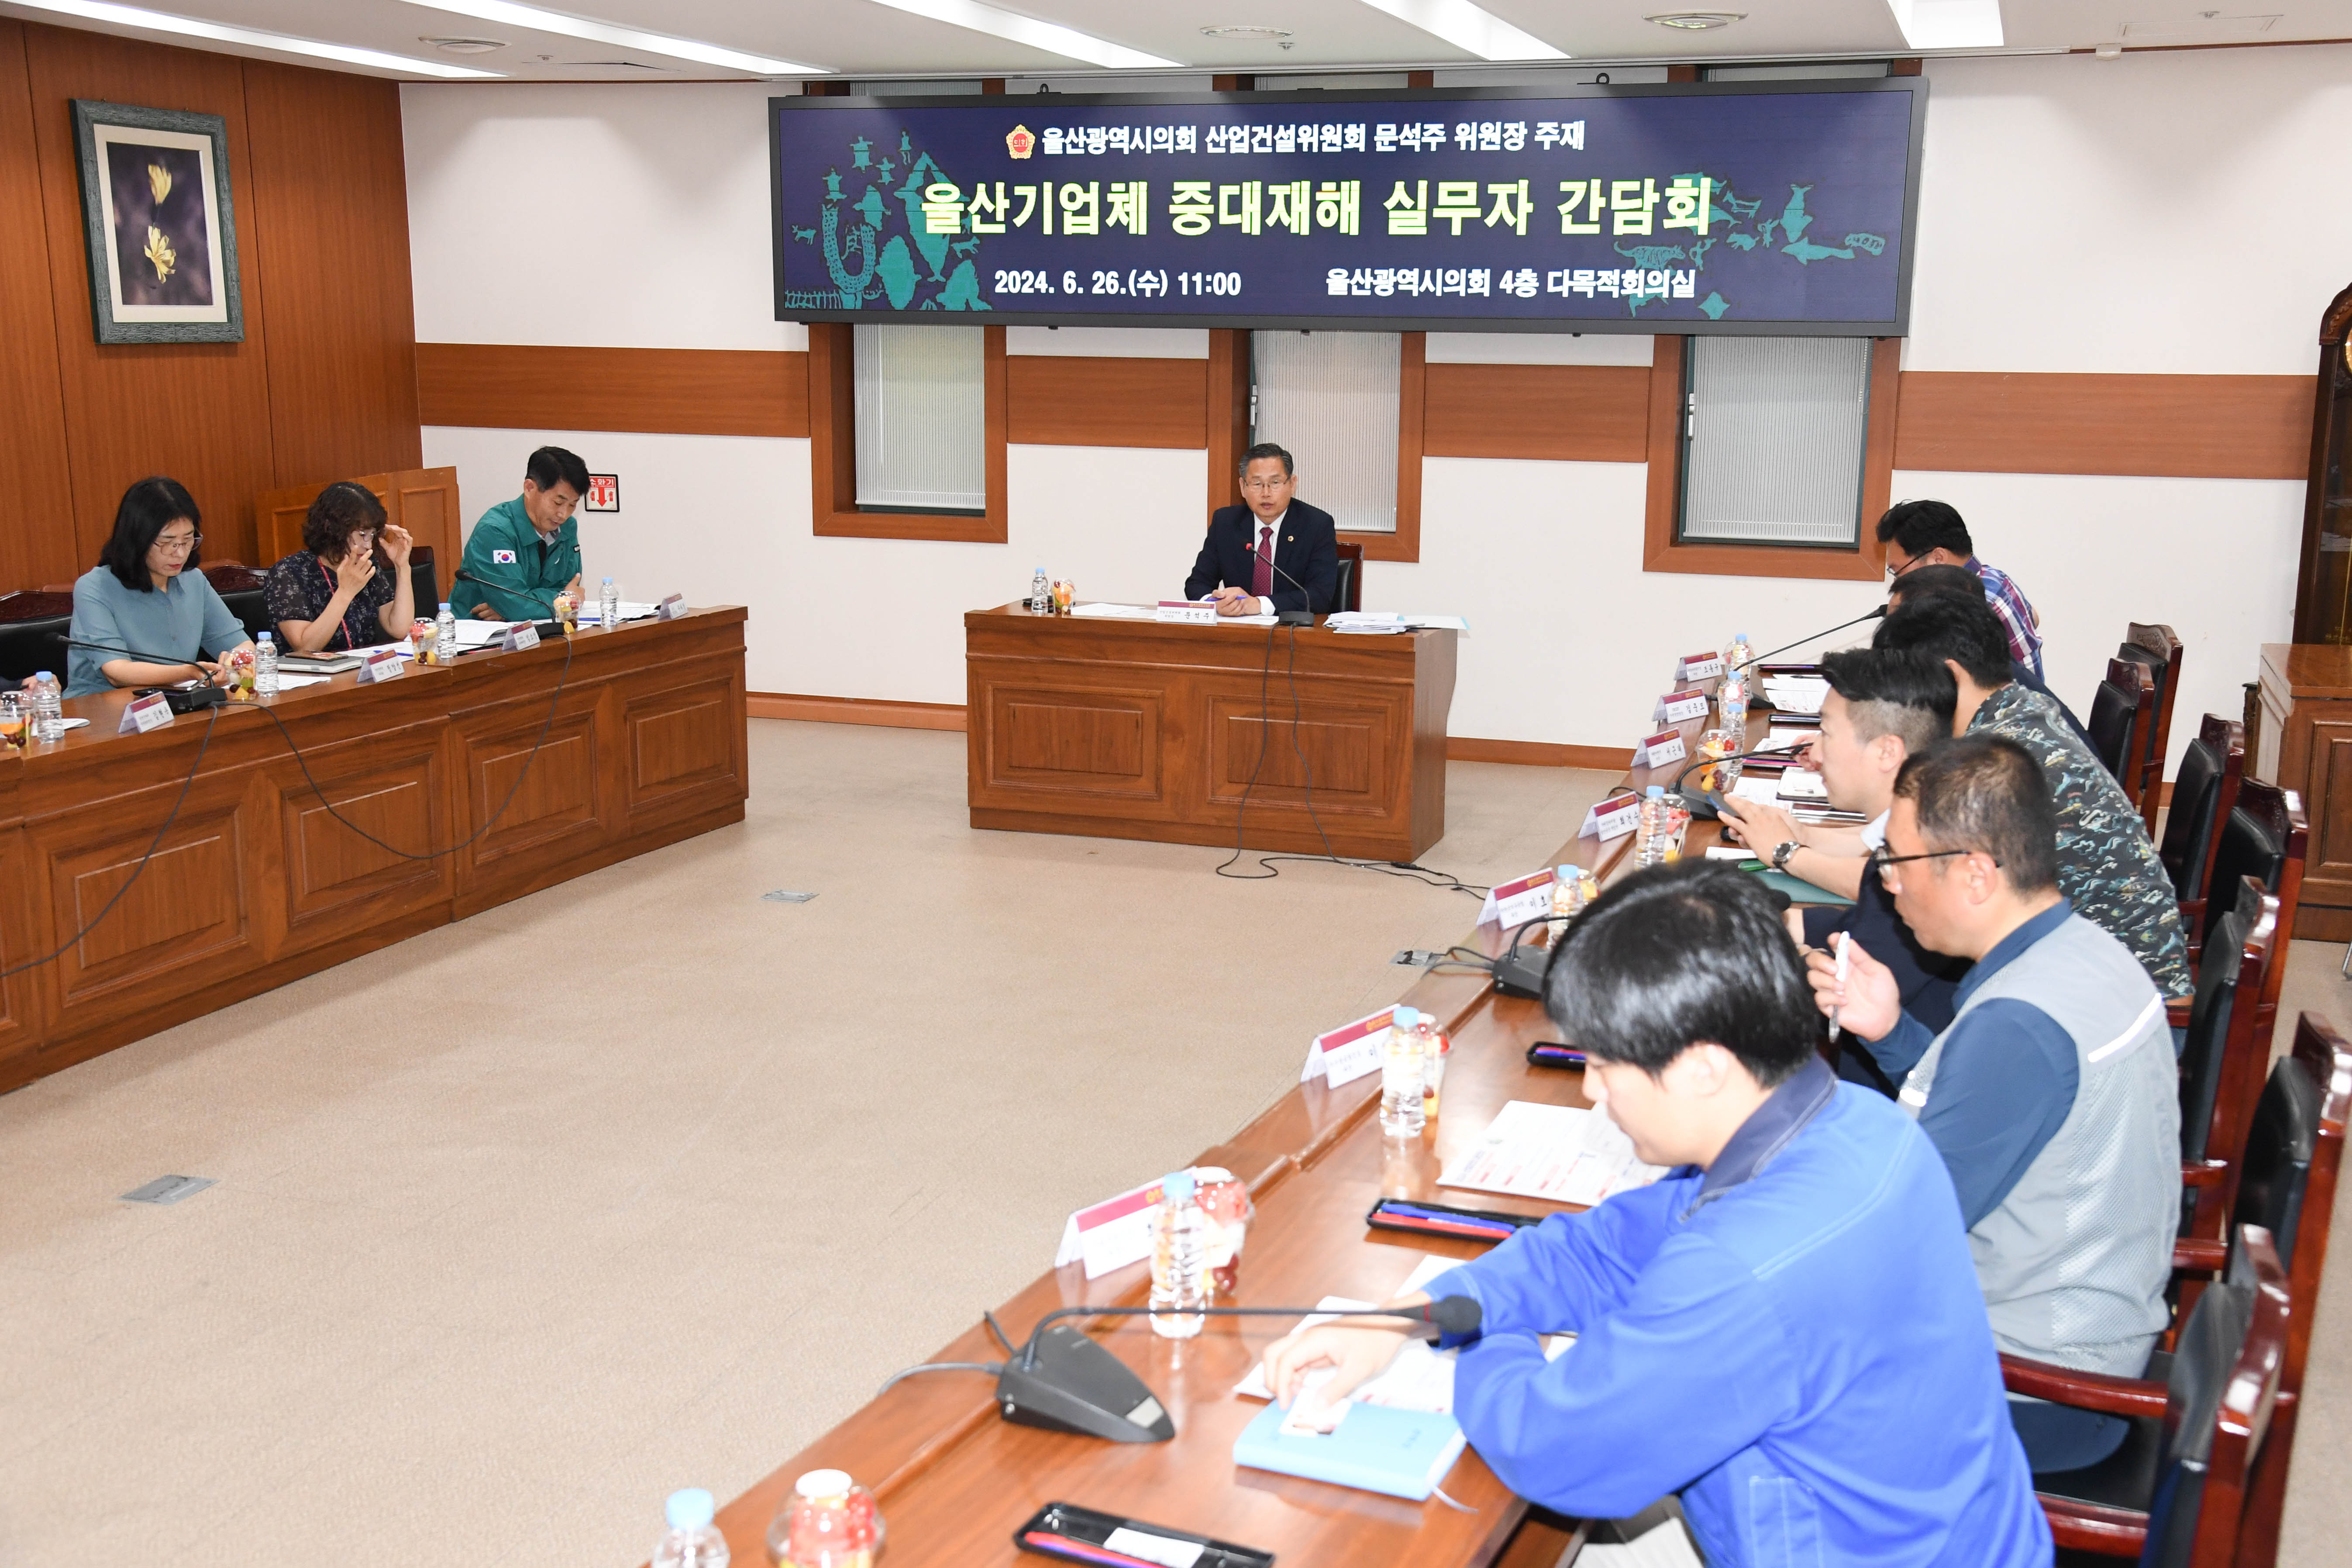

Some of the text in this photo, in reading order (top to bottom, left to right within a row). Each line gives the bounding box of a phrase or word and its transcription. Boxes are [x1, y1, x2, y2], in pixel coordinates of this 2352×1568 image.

[1042, 120, 1584, 154] 울산광역시의회 산업건설위원회 문석주 위원장 주재
[922, 177, 1711, 236] 울산기업체 중대재해 실무자 간담회
[995, 269, 1241, 297] 2024. 6. 26.(수) 11:00
[1326, 268, 1695, 299] 울산광역시의회 4층 다목적회의실
